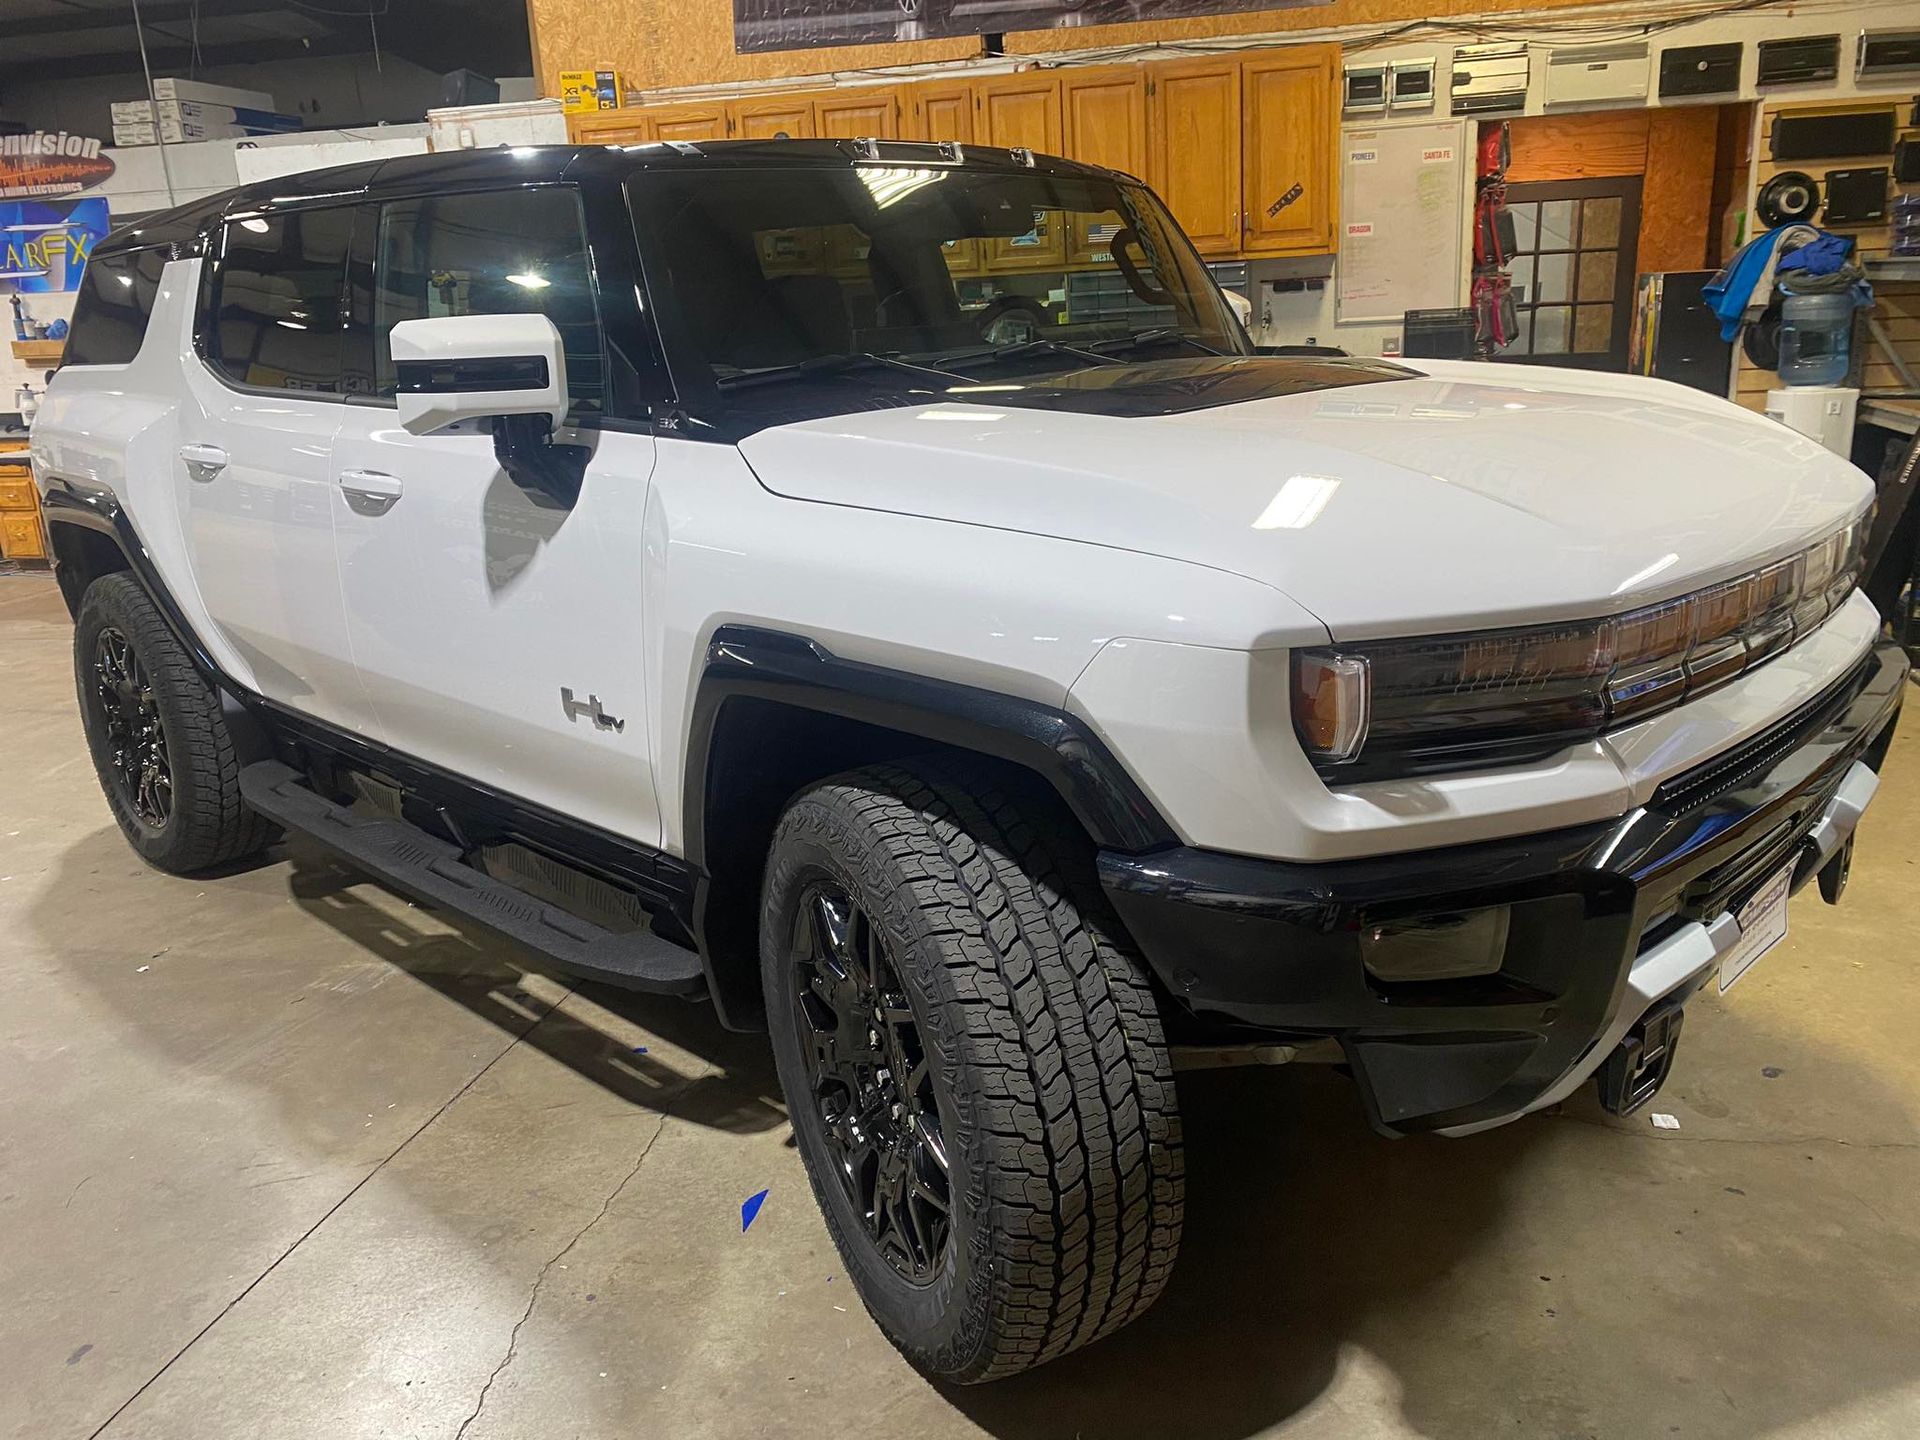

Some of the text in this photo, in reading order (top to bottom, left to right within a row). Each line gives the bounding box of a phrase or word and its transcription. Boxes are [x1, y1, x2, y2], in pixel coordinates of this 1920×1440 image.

[0, 130, 101, 160] nvision
[1351, 152, 1375, 160] PIONEER
[1423, 150, 1451, 160] SANTA FE
[1348, 225, 1371, 234] DRAGON
